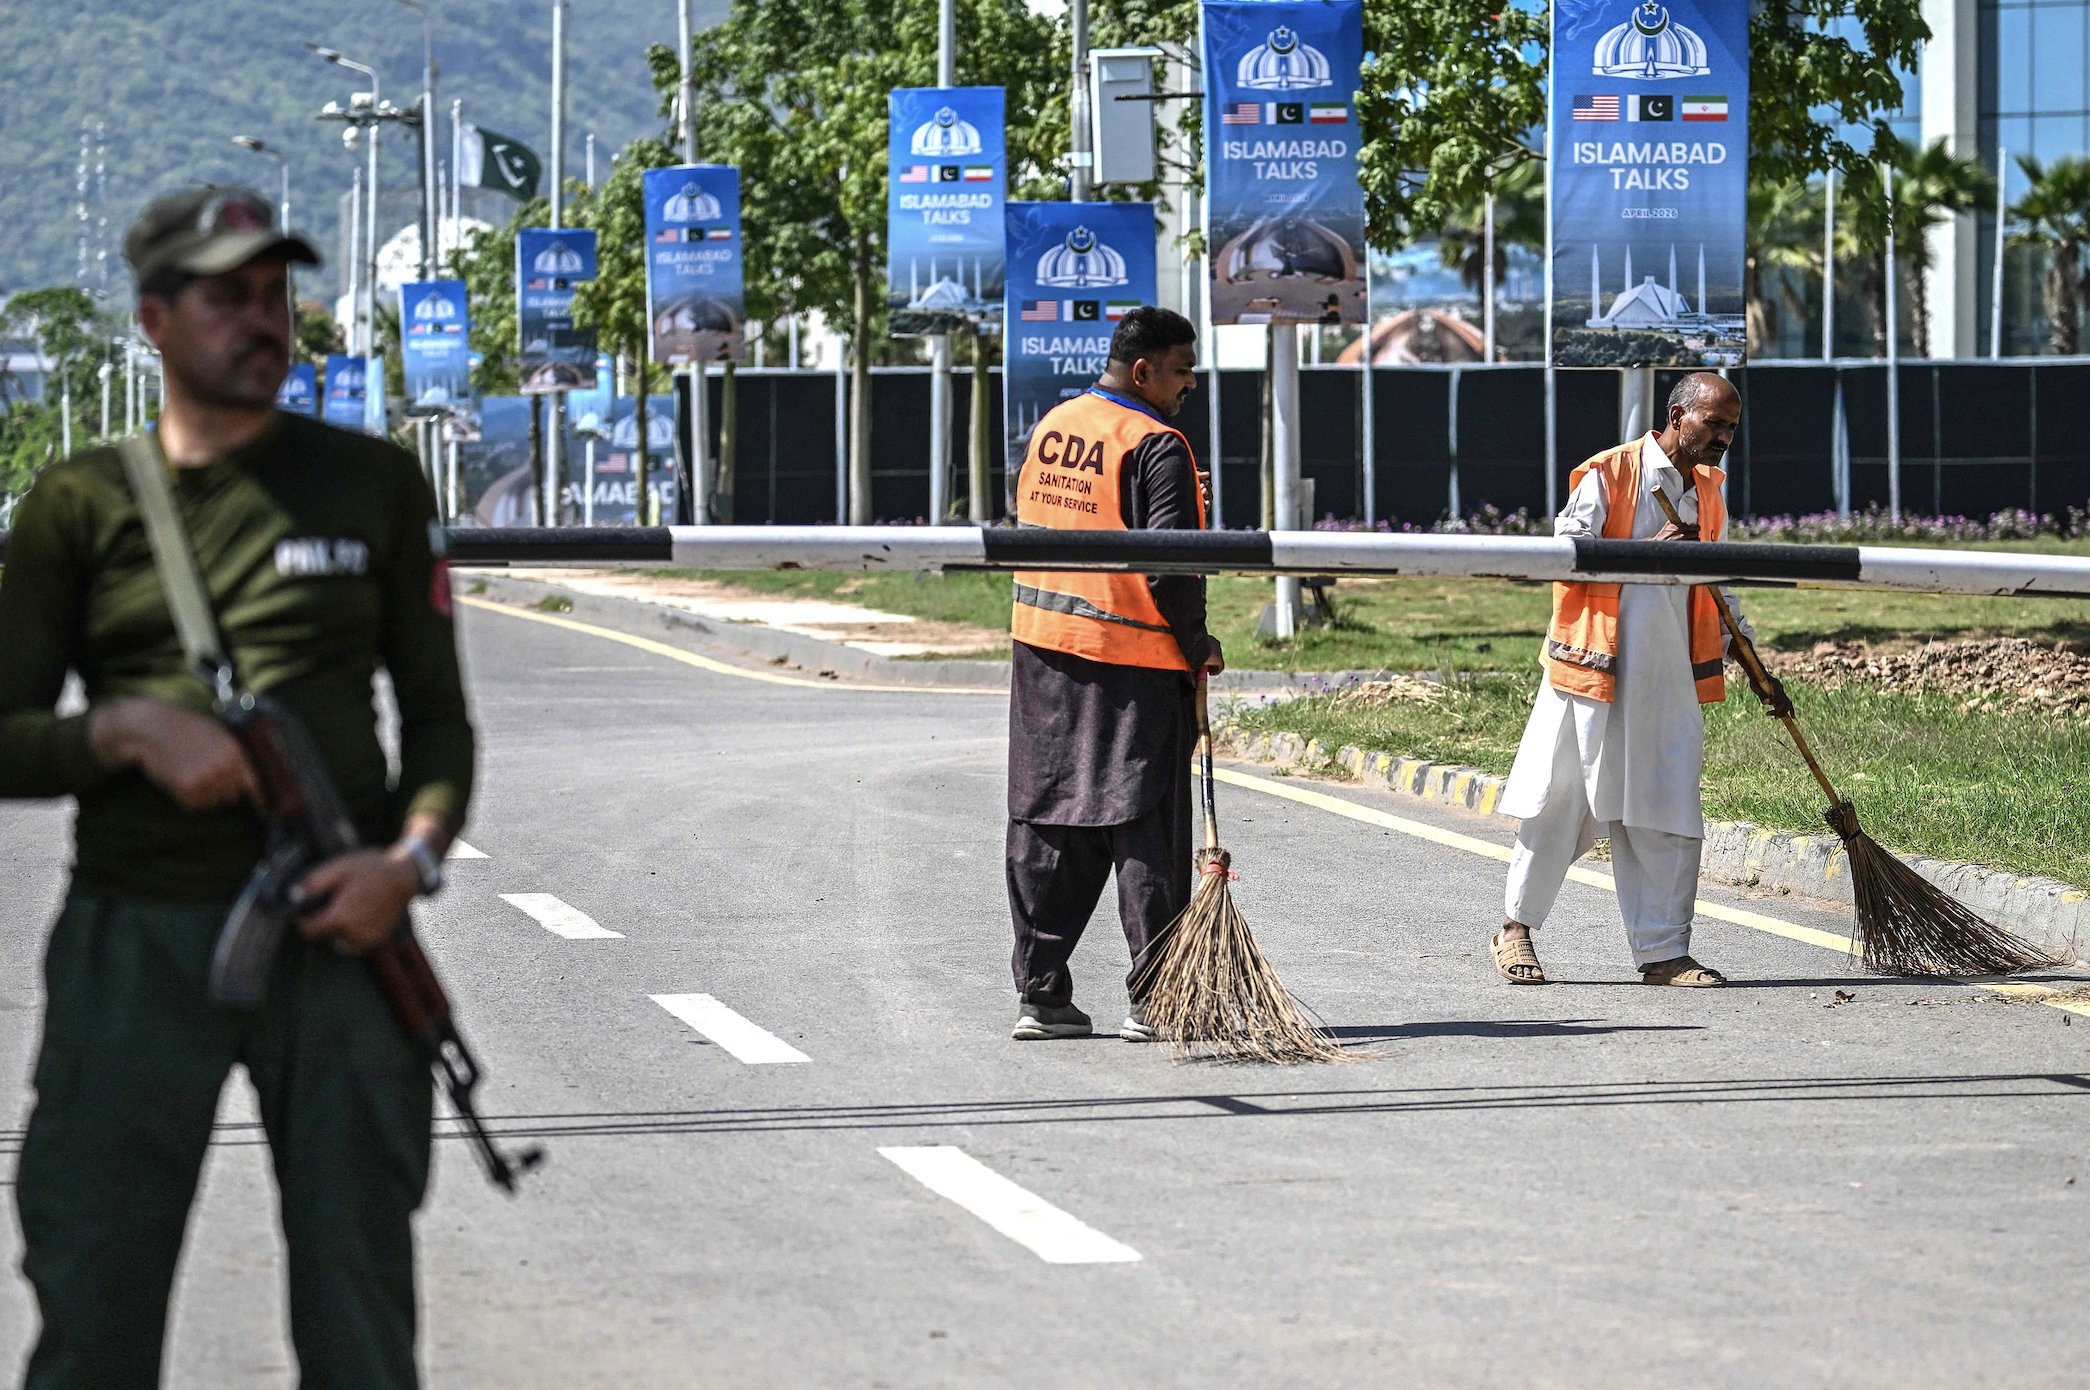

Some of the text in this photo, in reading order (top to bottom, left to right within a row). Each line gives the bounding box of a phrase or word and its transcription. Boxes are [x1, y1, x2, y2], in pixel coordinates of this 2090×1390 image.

[1223, 140, 1347, 159] ISLAMABAD
[1573, 142, 1727, 164] ISLAMABAD
[1252, 161, 1318, 179] TALKS
[1609, 168, 1690, 190] TALKS
[899, 193, 993, 210] ISLAMABAD
[922, 210, 971, 225] TALKS
[1621, 208, 1650, 219] APRIL
[1021, 336, 1111, 355] ISLAMAB
[1038, 431, 1104, 476] CDA
[1039, 472, 1092, 495] SANITATION
[1029, 491, 1098, 514] AT YOUR SERVICE
